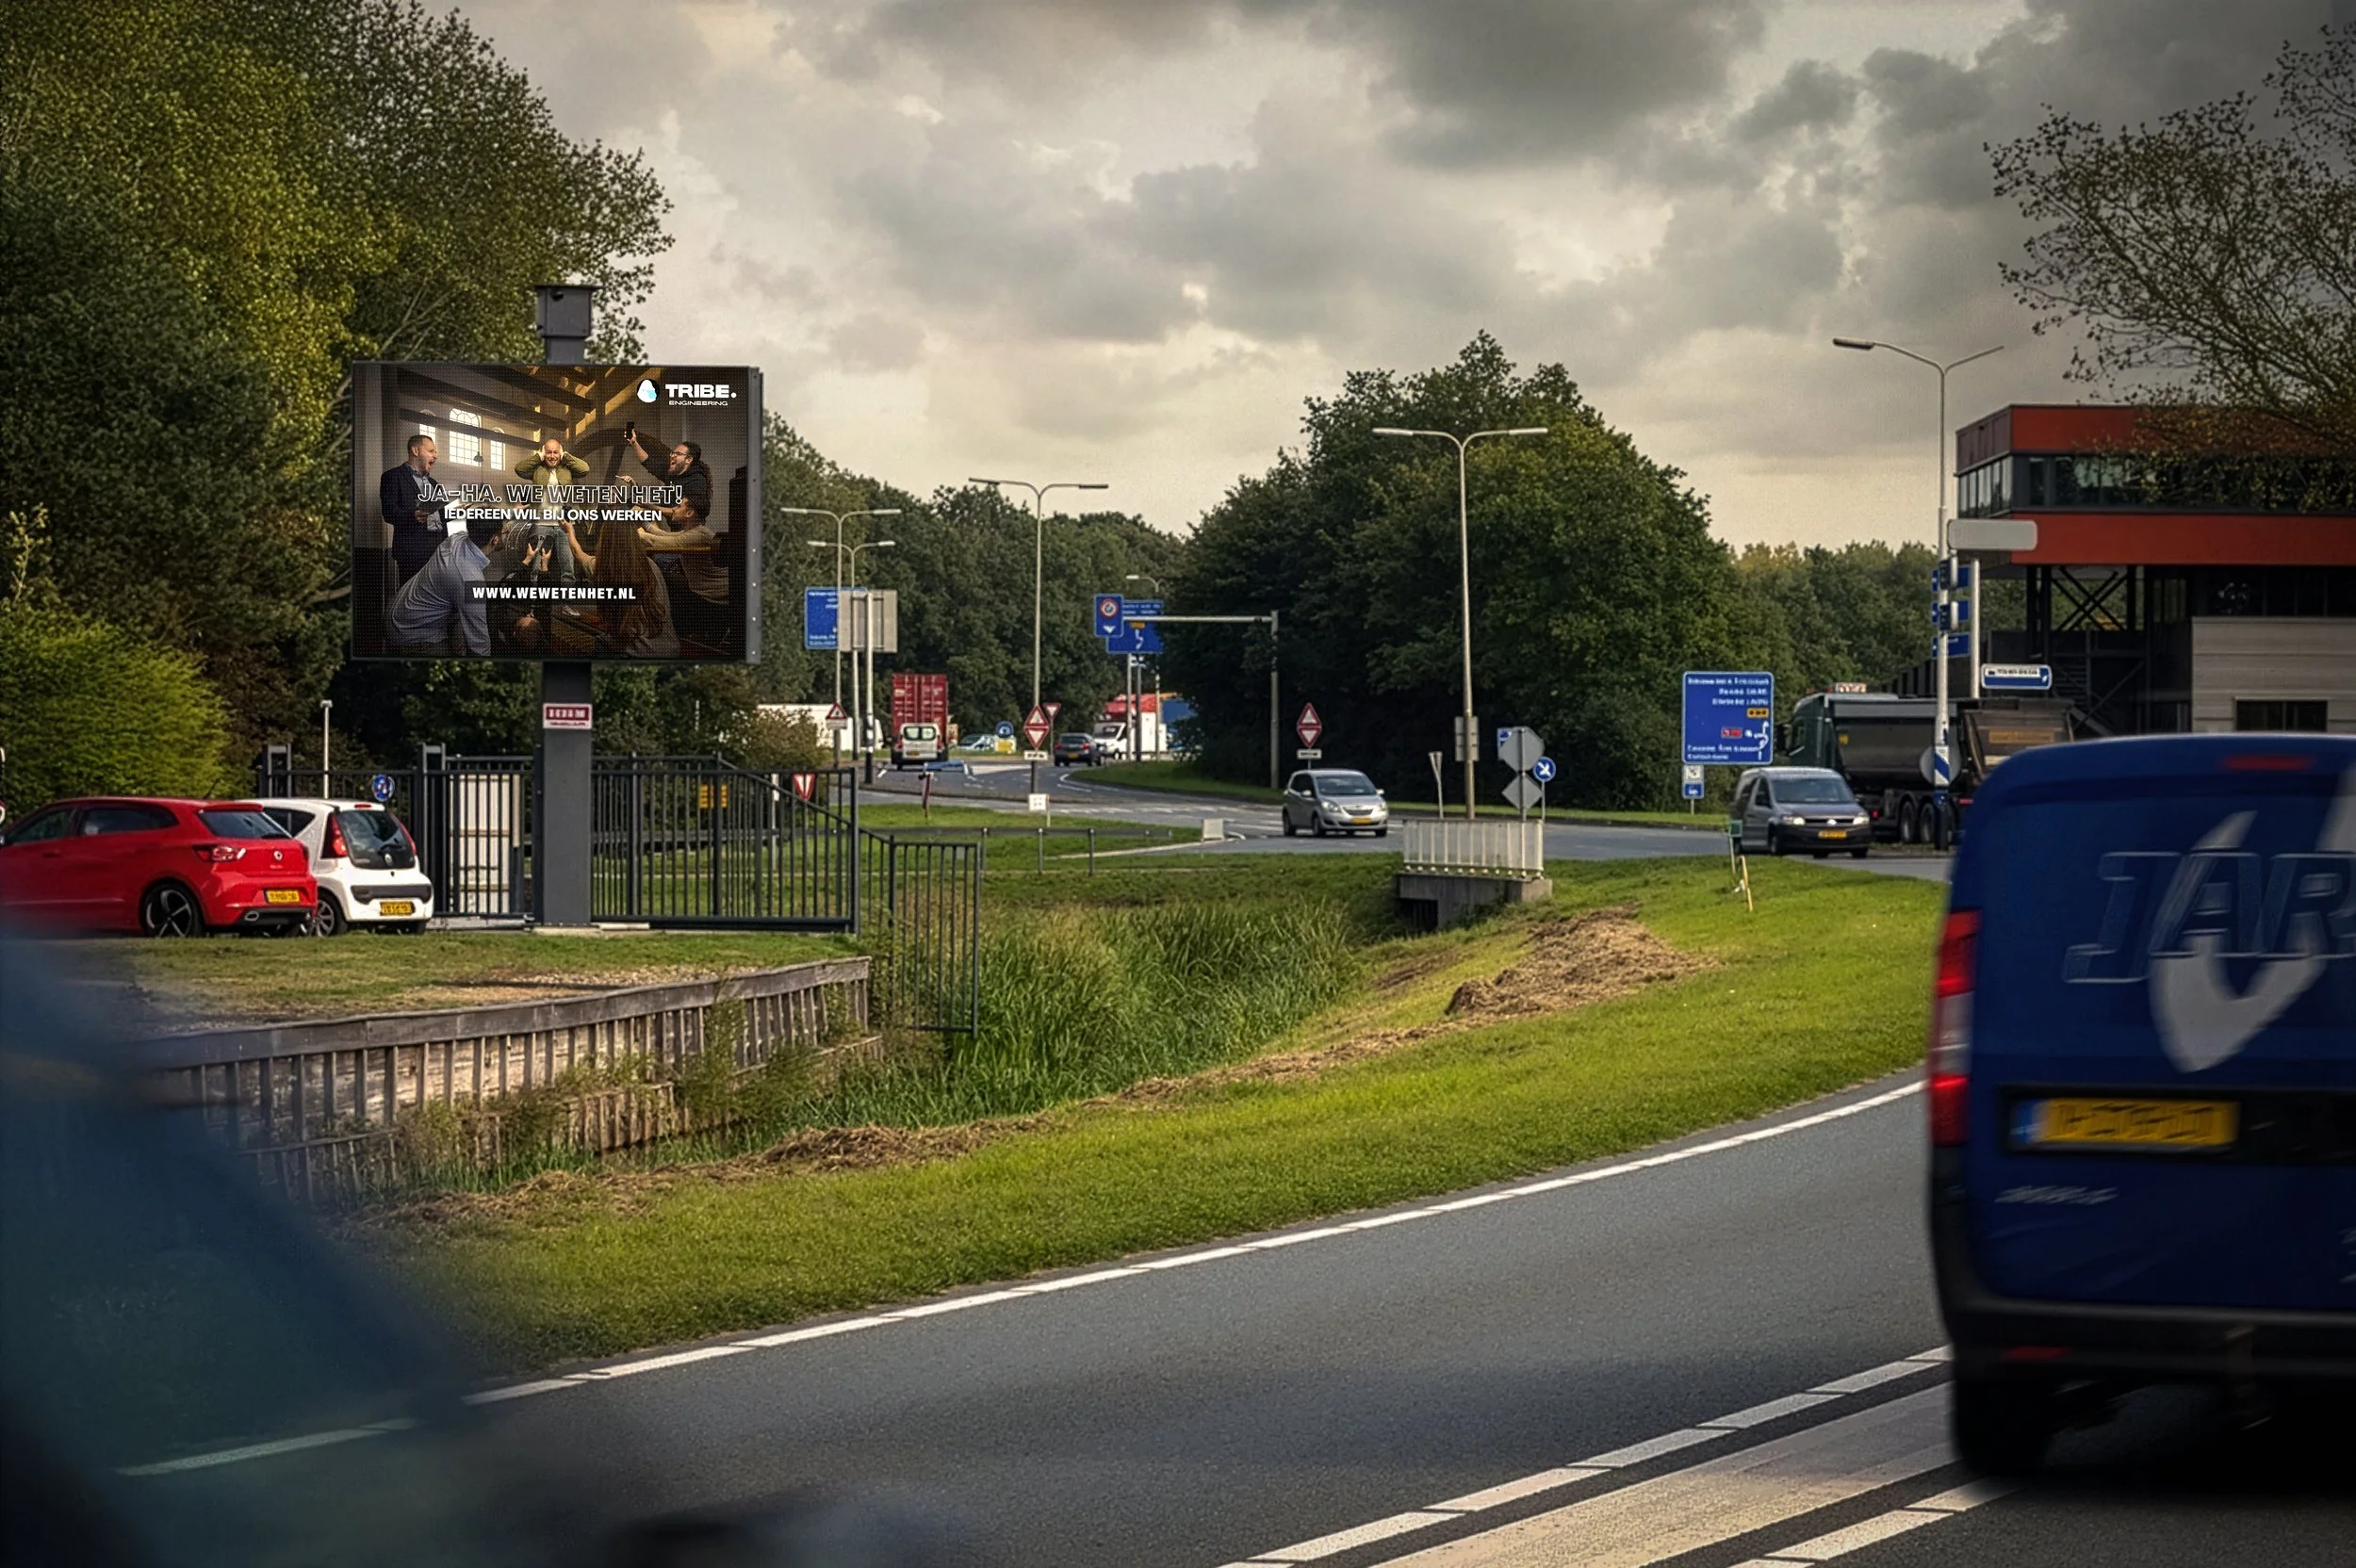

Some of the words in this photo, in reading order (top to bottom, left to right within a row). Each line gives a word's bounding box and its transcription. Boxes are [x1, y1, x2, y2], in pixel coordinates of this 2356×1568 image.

[665, 384, 737, 399] TRIBE.
[417, 483, 502, 502] JA-HA.
[506, 484, 544, 503] WE
[548, 485, 627, 504] WETEN
[631, 485, 682, 504] HET!
[444, 508, 512, 519] IEDEREEN
[514, 509, 540, 520] WIL
[543, 510, 564, 520] BIJ
[567, 509, 598, 521] ONS
[601, 510, 663, 521] WERKEN
[472, 587, 636, 599] WWW.WEWETENHET.NL
